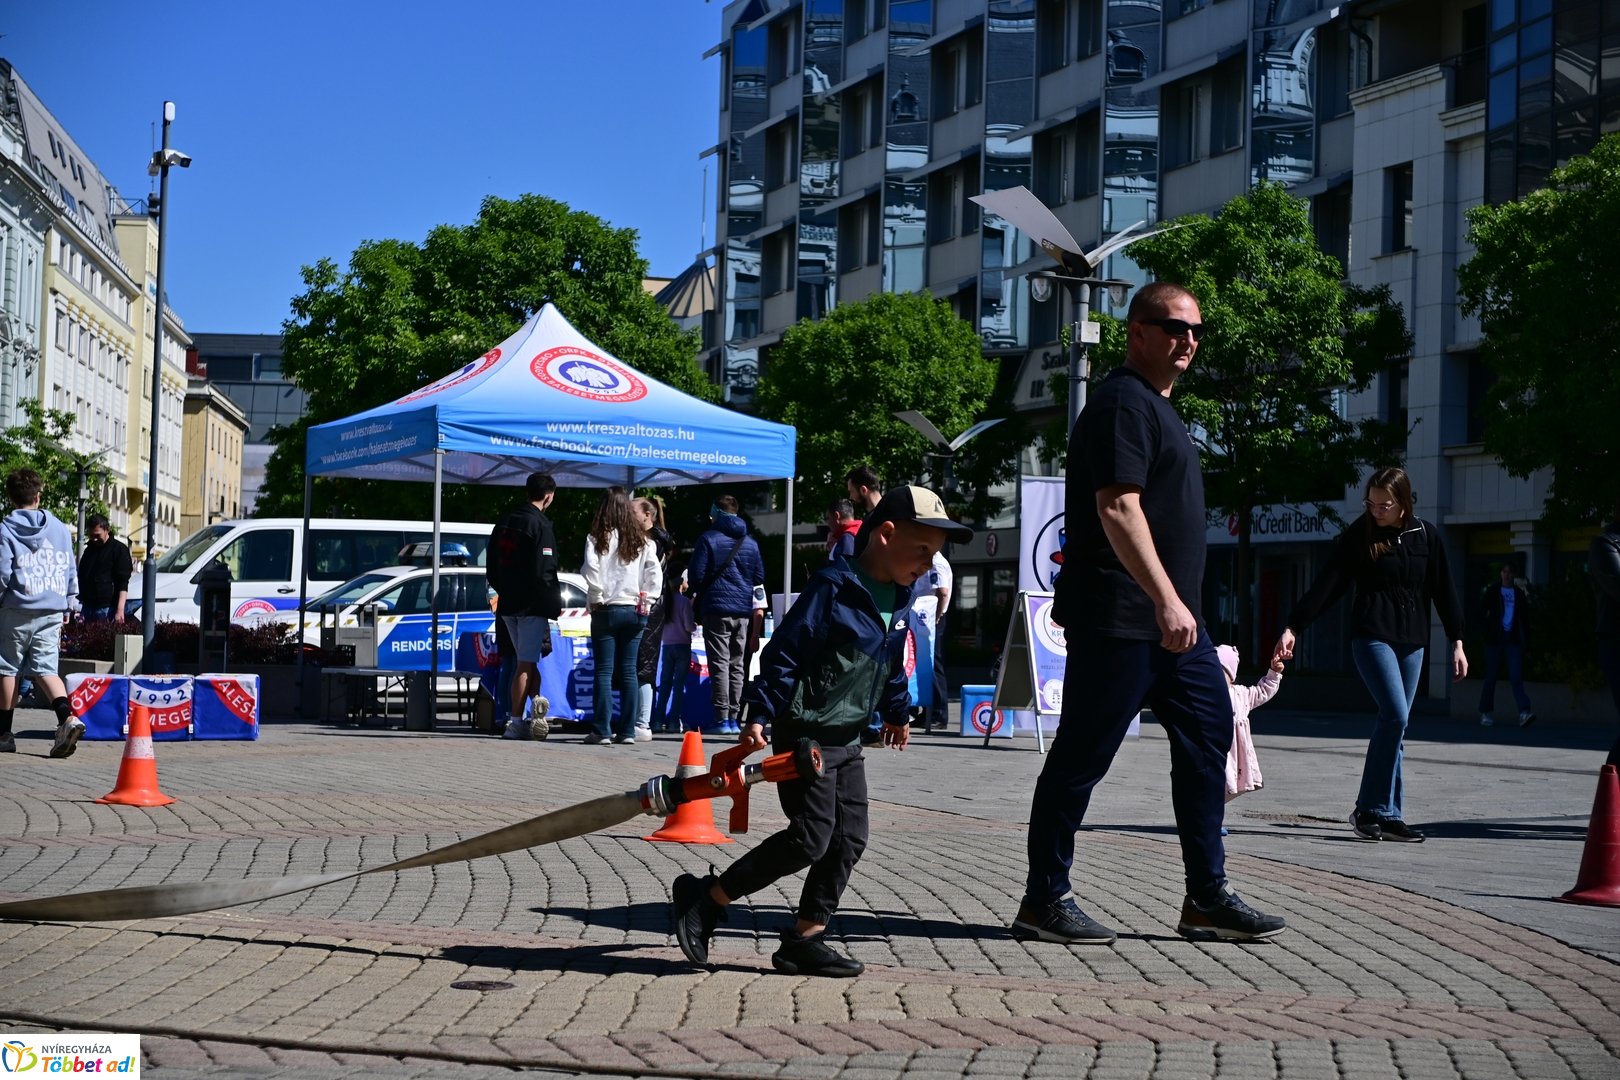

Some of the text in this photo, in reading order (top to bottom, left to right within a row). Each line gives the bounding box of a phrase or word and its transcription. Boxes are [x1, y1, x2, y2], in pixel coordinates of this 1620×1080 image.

[546, 421, 695, 441] www.kreszvaltozas.hu
[490, 434, 748, 465] www.facebook.com/balesetmegelozes
[1248, 510, 1326, 535] niCredit Bank
[391, 636, 459, 653] RENDŐRS
[135, 689, 187, 705] 1992
